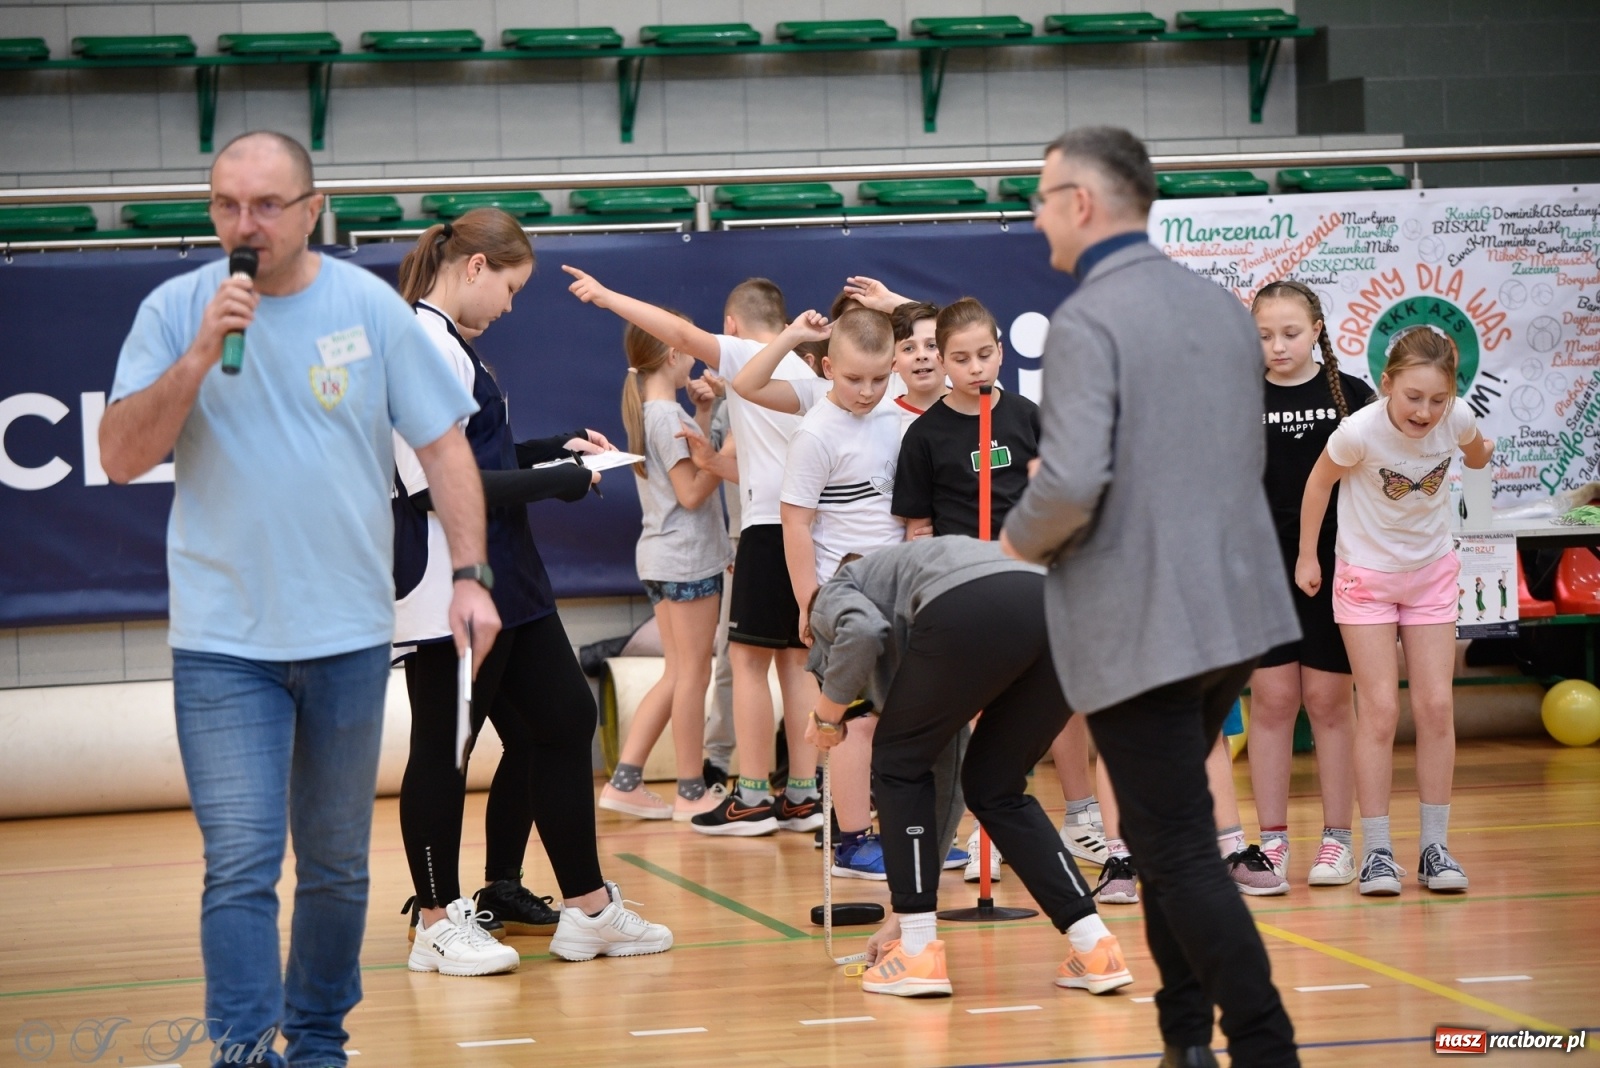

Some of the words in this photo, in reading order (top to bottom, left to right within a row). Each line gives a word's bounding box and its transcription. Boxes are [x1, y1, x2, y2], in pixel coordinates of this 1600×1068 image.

[1341, 210, 1396, 229] Martyna
[1551, 204, 1600, 222] Szatany
[1336, 267, 1406, 357] GRAMY
[1415, 262, 1464, 301] DLA
[1465, 287, 1512, 352] WAS
[1378, 301, 1419, 336] RKK
[1427, 302, 1467, 333] AZS
[1281, 422, 1315, 433] HAPPY
